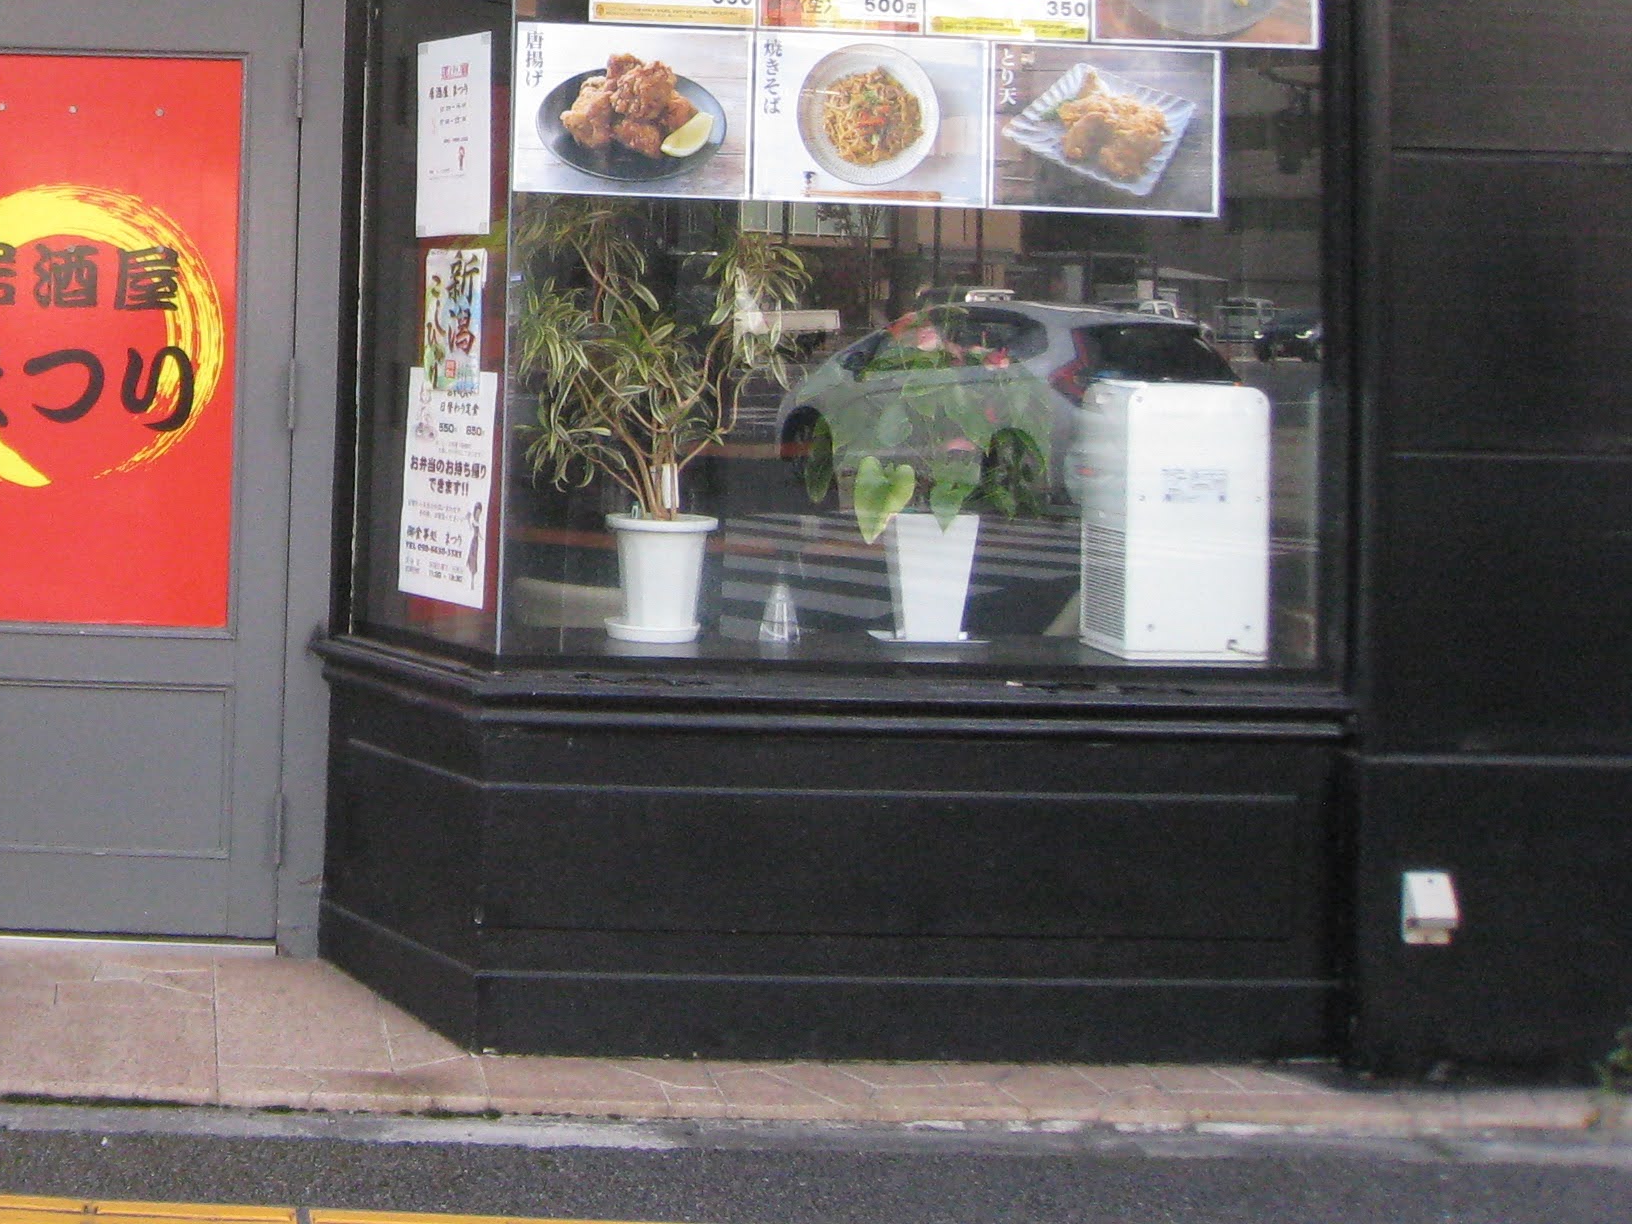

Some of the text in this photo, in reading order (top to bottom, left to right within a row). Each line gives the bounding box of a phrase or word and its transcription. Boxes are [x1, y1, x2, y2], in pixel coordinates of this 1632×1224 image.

[1047, 1, 1085, 17] 350
[525, 31, 544, 87] 唐揚げ
[763, 39, 783, 115] 焼きそば
[999, 49, 1017, 106] とり天
[446, 251, 480, 355] 新潟
[410, 455, 487, 480] お弁当のお持ち帰り
